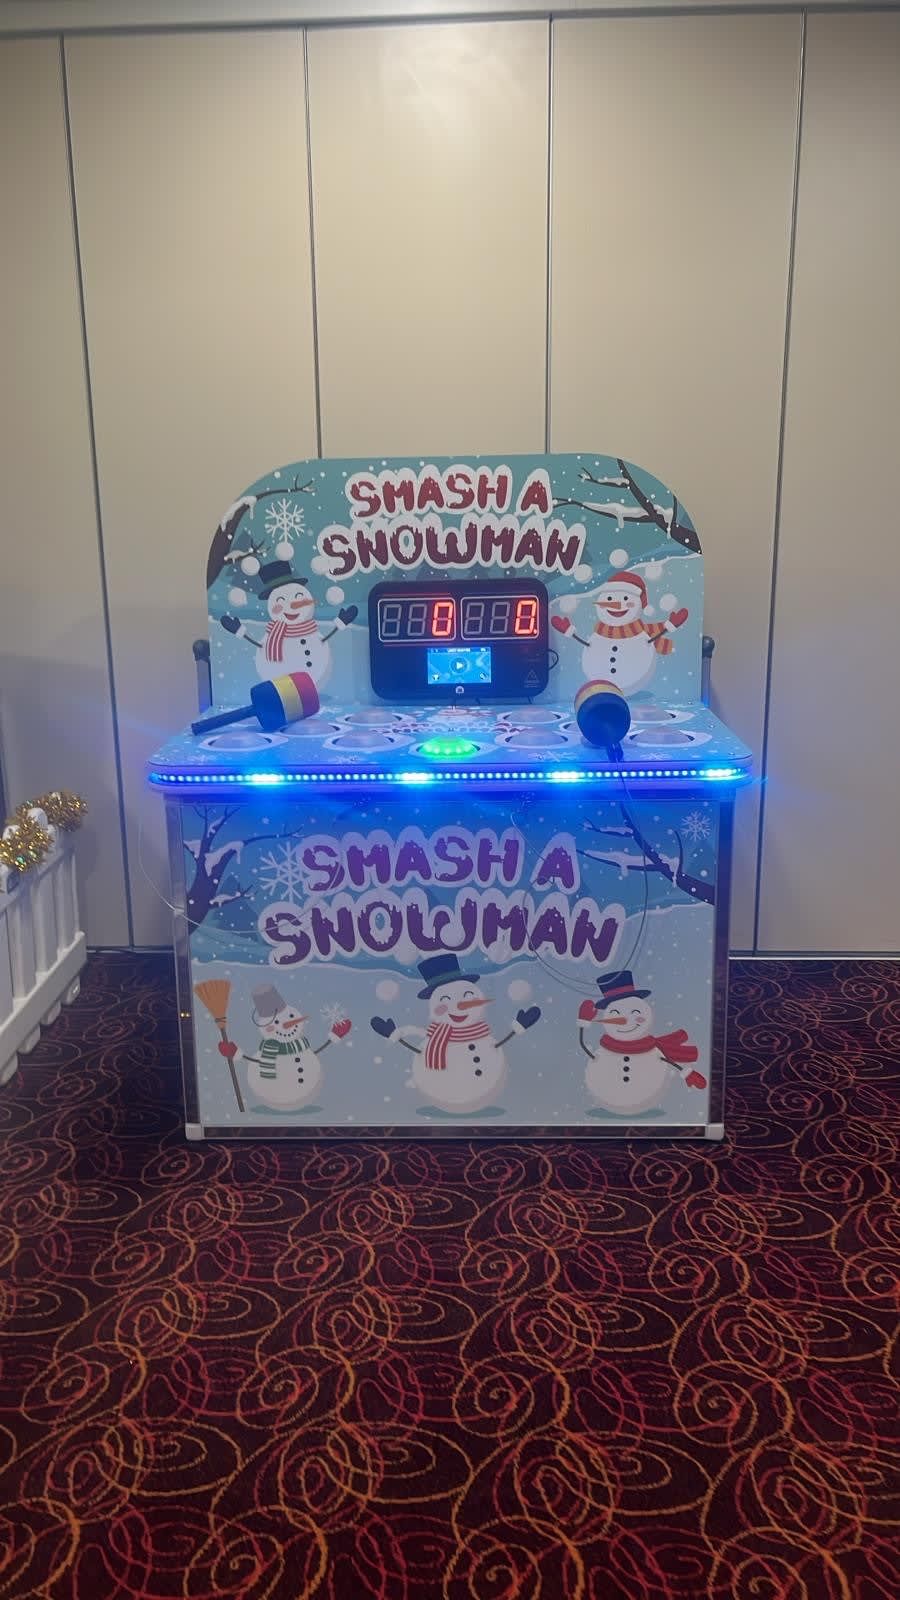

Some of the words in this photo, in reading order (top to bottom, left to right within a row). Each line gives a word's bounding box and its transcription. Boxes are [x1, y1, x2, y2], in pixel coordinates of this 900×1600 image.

[349, 469, 510, 519] SMASH
[518, 475, 551, 515] A
[320, 518, 583, 578] SNOWMAN
[300, 831, 522, 893] SMASH
[534, 840, 577, 892] A
[262, 894, 621, 966] SNOWMAN
